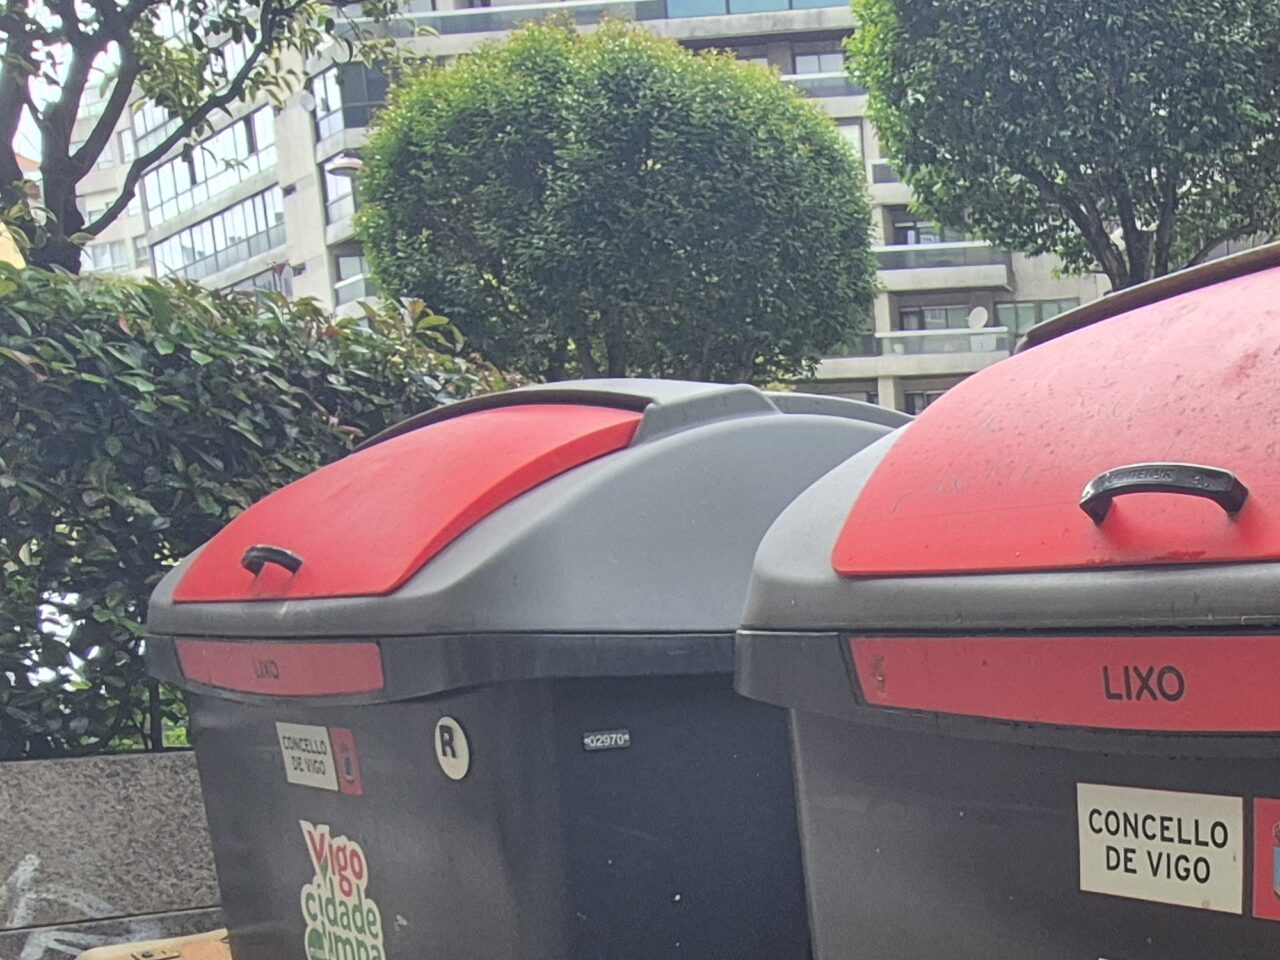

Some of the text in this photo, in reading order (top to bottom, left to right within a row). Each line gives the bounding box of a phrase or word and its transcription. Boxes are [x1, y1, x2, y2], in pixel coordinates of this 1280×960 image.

[1102, 666, 1185, 701] LIXO
[282, 735, 328, 756] CONCELLO
[438, 724, 458, 760] R
[291, 755, 326, 776] DE VIGO
[1088, 808, 1229, 849] CONCELLO
[1105, 845, 1211, 884] DE VIGO
[304, 876, 379, 940] cidade
